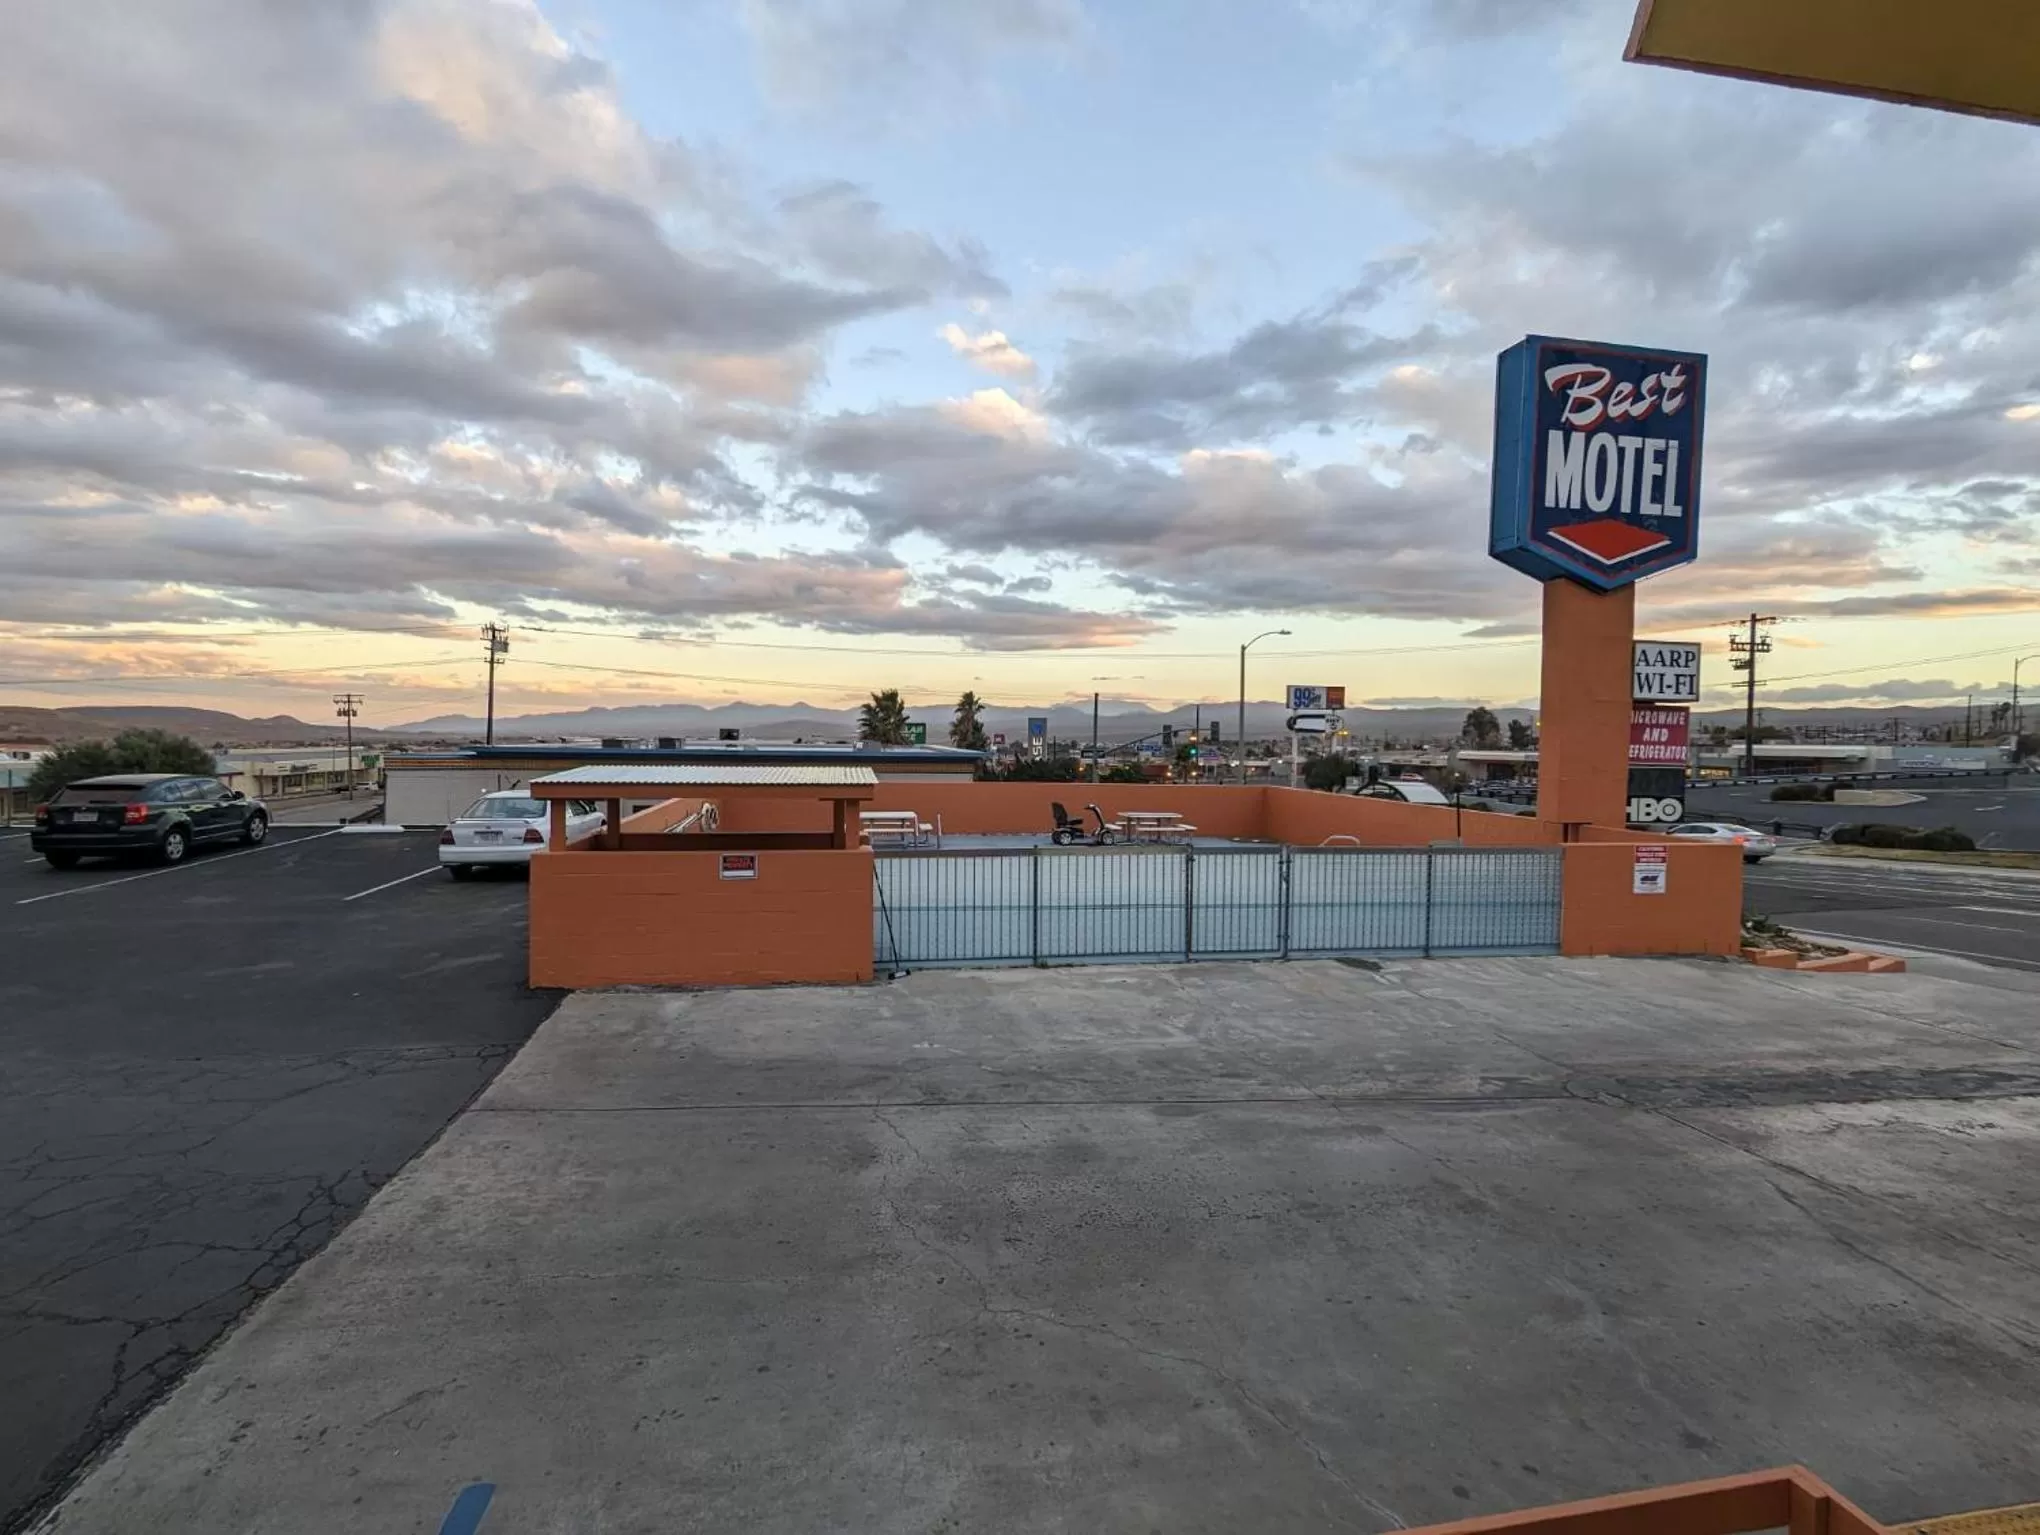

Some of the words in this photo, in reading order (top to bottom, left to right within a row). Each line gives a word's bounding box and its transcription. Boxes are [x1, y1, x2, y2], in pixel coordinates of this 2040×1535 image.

[1544, 363, 1687, 430] Best
[1544, 430, 1683, 517] MOTEL
[1635, 649, 1696, 668] AARP
[1635, 673, 1696, 695] WI-FI
[1642, 727, 1669, 742] AND
[1628, 744, 1687, 760] EFRIGERATOR
[1626, 797, 1683, 821] HBO
